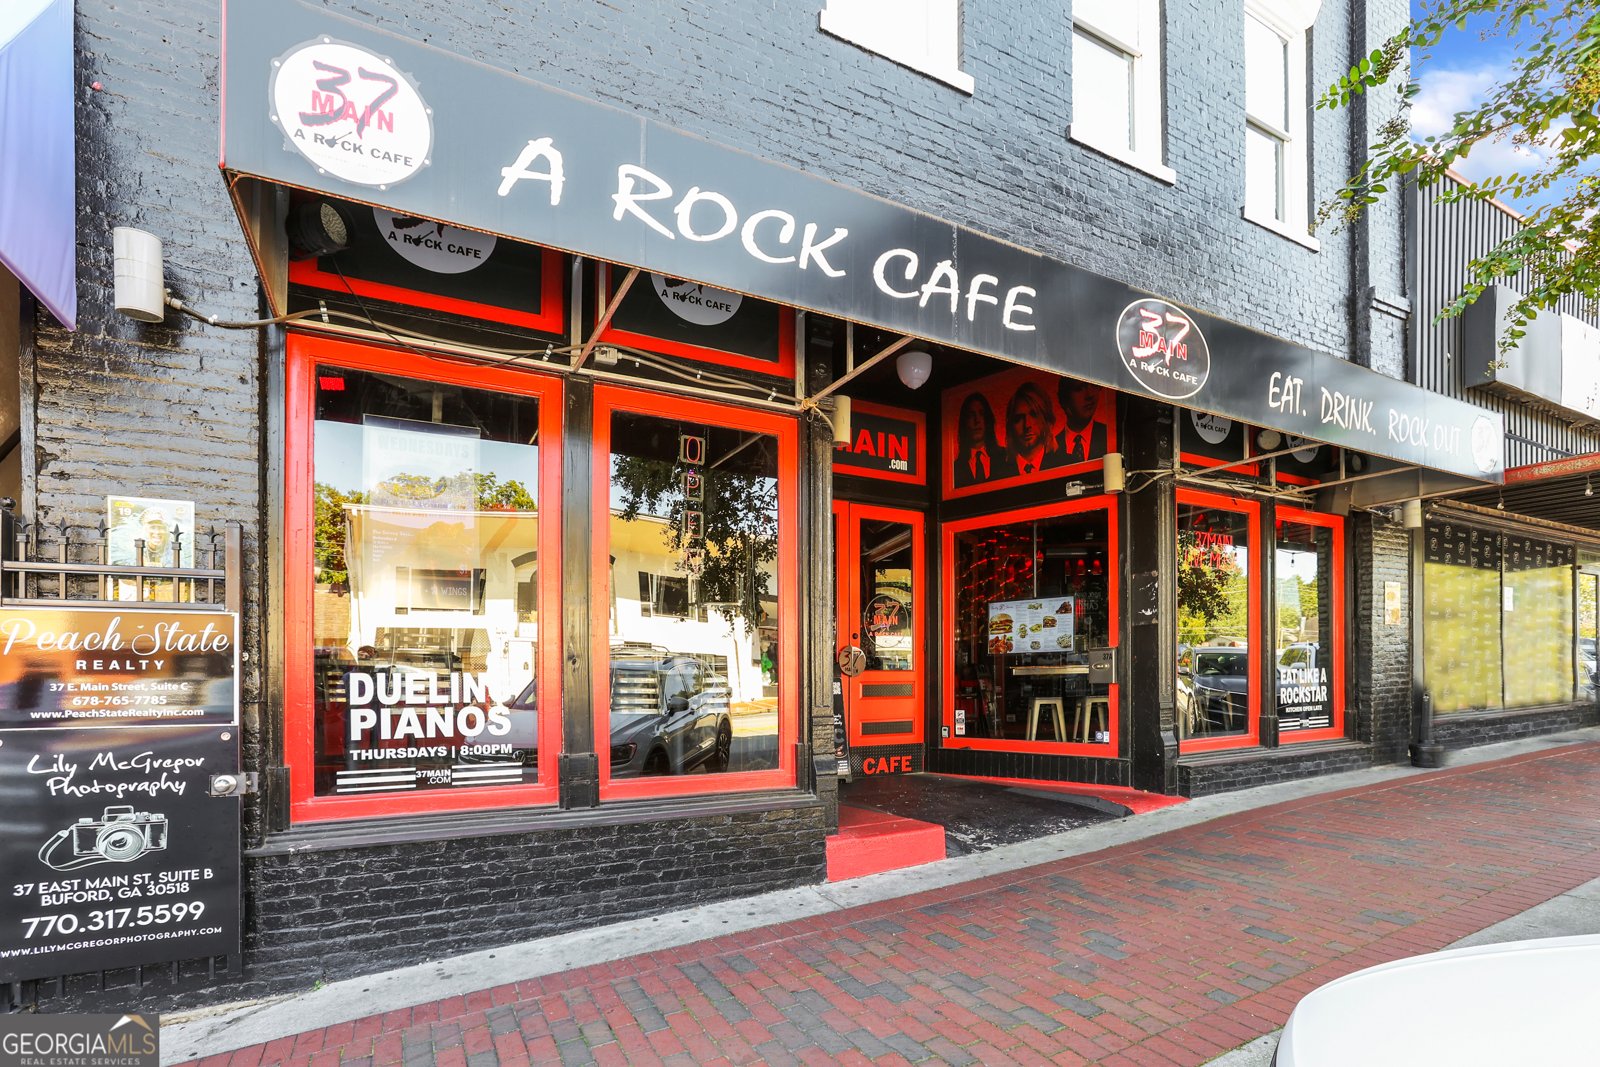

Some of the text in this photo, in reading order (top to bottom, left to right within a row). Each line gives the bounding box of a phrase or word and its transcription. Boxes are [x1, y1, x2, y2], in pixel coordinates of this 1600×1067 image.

[299, 60, 399, 139] 37
[311, 90, 394, 133] MAIN
[294, 128, 306, 140] A
[370, 148, 413, 167] CAFE
[388, 231, 398, 241] A
[447, 244, 482, 260] CAFE
[497, 137, 1037, 332] A ROCK CAFE
[661, 289, 669, 298] A
[705, 299, 732, 313] CAFE
[1132, 308, 1190, 367] 37
[1139, 330, 1188, 361] MAIN
[1129, 358, 1138, 368] A
[1172, 371, 1199, 386] CAFE
[1268, 371, 1307, 417] EAT.
[1321, 386, 1377, 436] DRINK.
[1388, 408, 1430, 448] ROCK
[1434, 423, 1463, 458] OUT
[377, 433, 470, 459] WEDNESDAYS
[889, 459, 908, 471] .com
[118, 507, 132, 516] 19
[440, 587, 468, 596] WINGS
[873, 615, 898, 626] MAIN
[0, 616, 230, 655] Peach State
[76, 659, 166, 671] REALTY
[1280, 667, 1328, 684] EAT LIKE A
[50, 683, 65, 692] 37
[67, 683, 78, 692] E.
[80, 682, 109, 692] Main
[111, 682, 149, 693] Street,
[150, 682, 178, 692] Suite
[72, 695, 168, 706] 678-765-7785
[1280, 686, 1328, 705] ROCKSTAR
[30, 708, 204, 719] www.PeachStateRealtyInc.com
[350, 706, 512, 741] PIANOS
[26, 751, 206, 779] Lily McGregor
[350, 745, 448, 761] THURSDAYS
[459, 743, 513, 756] 8:00PM
[415, 769, 451, 778] 37MAIN
[862, 756, 913, 775] CAFE
[46, 772, 188, 798] Photography
[426, 776, 451, 785] .COM
[13, 867, 214, 897] 37 EAST MAIN ST, SUITE B
[40, 881, 190, 907] BUFORD, GA 30518
[20, 901, 206, 939] 770.317.5599
